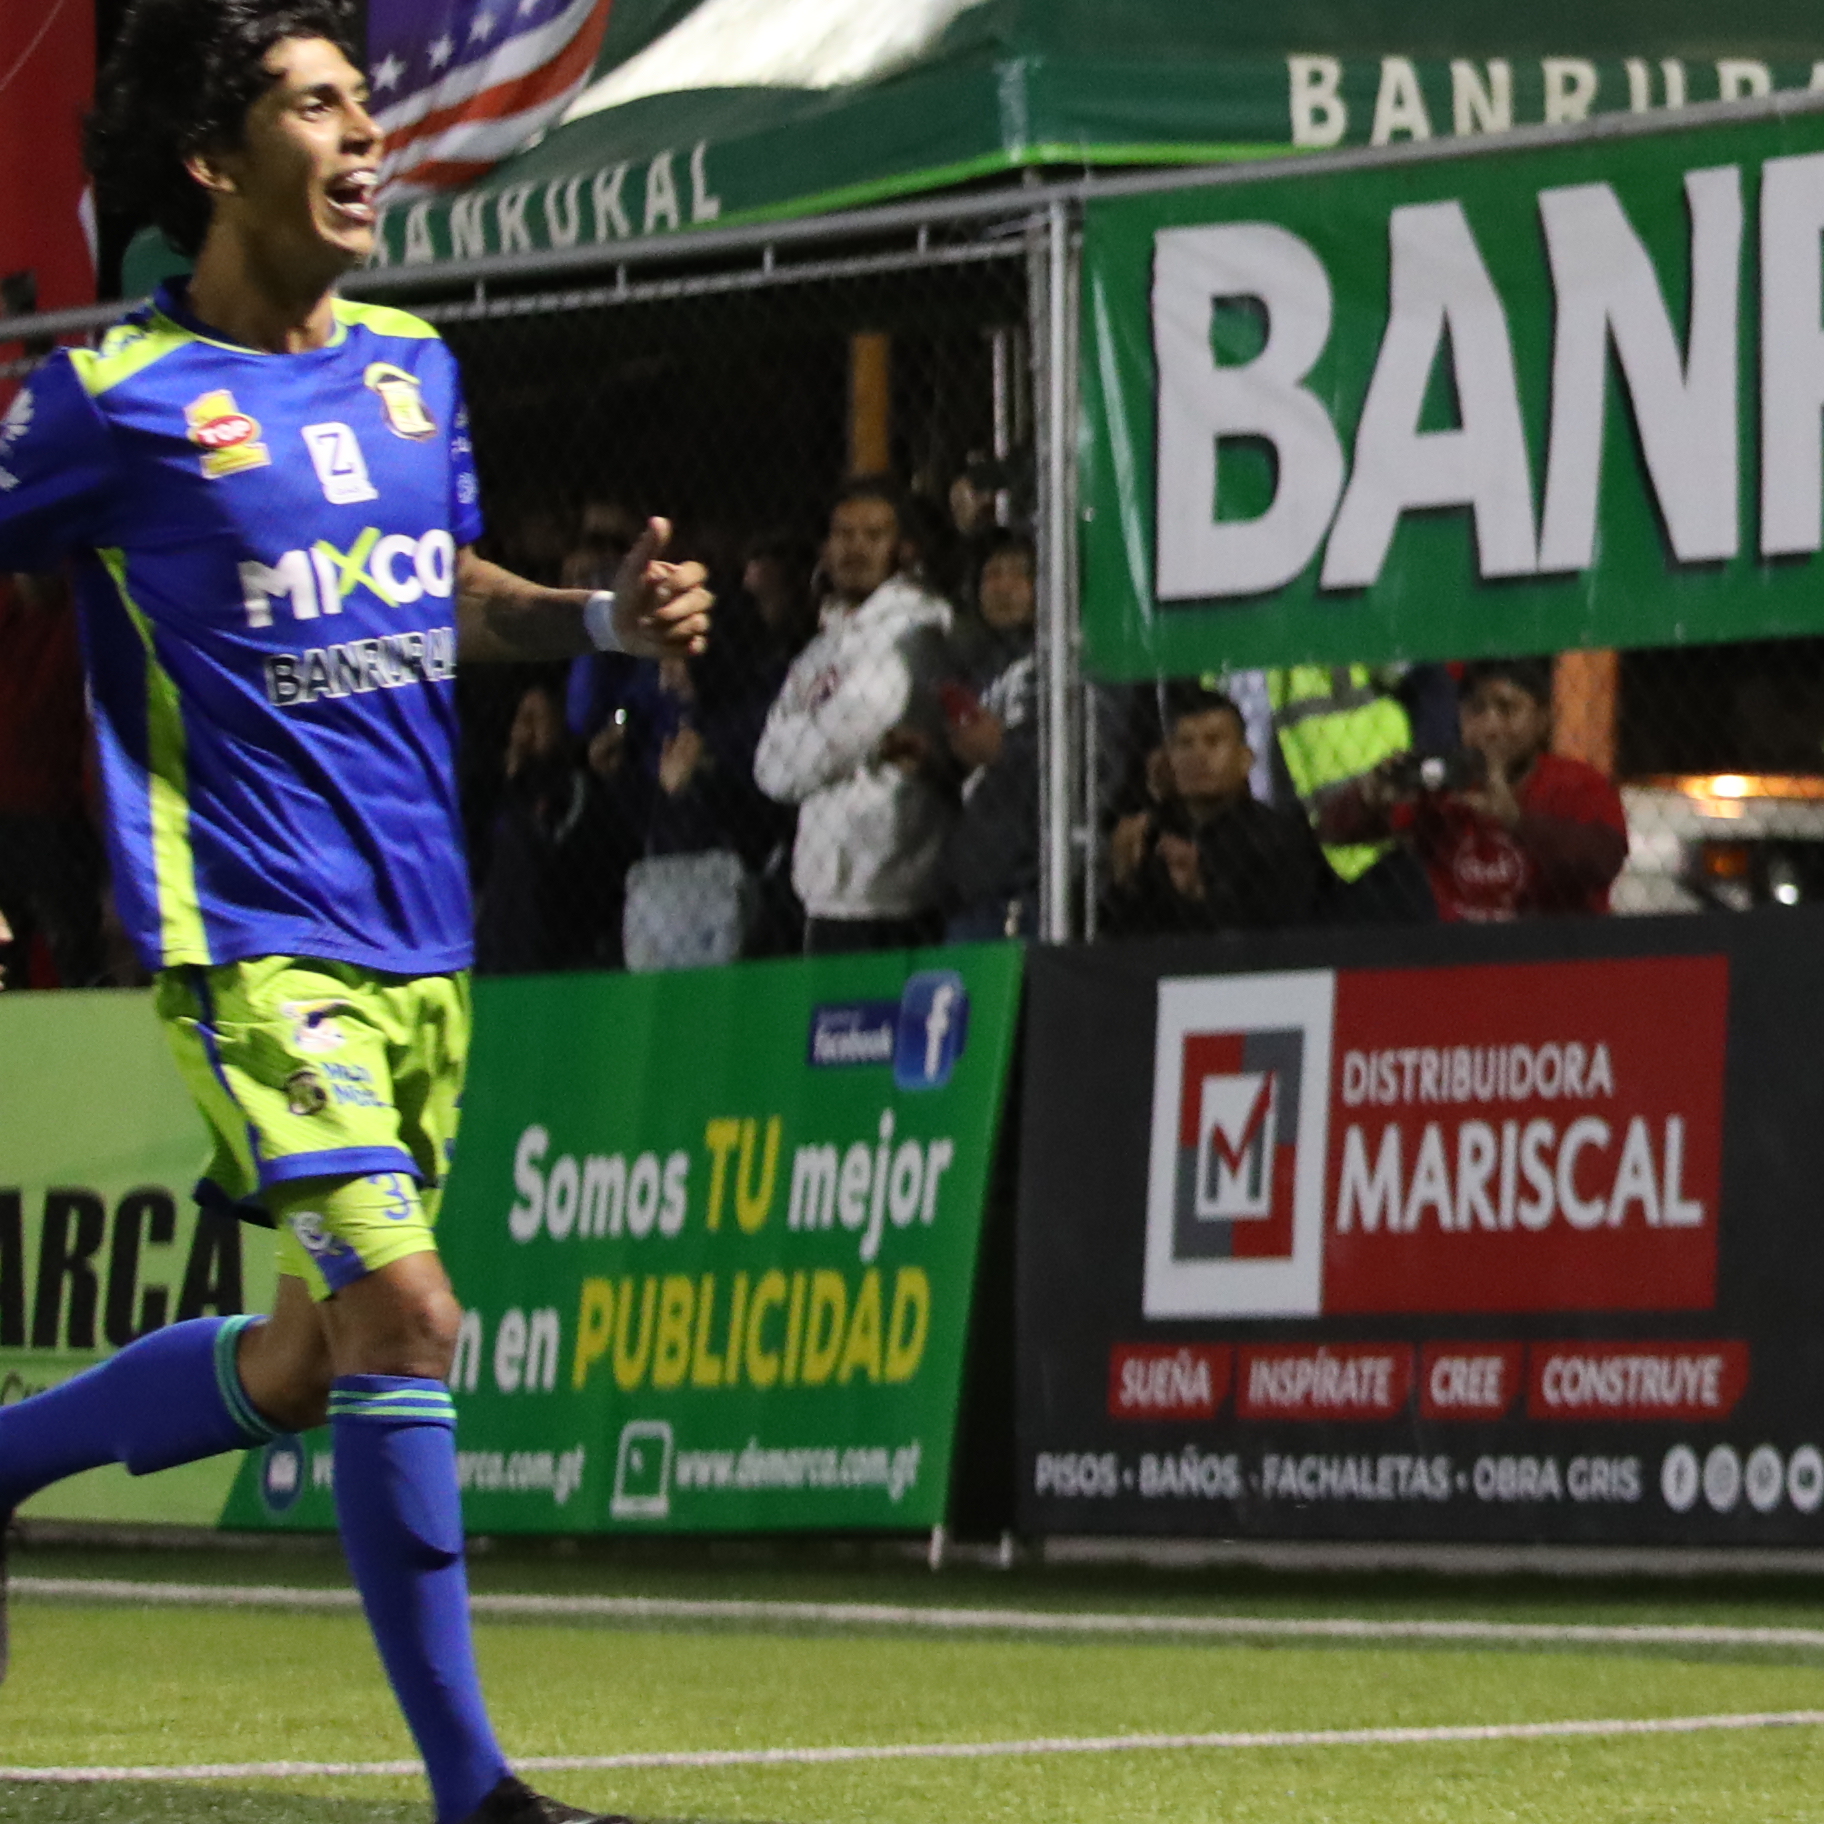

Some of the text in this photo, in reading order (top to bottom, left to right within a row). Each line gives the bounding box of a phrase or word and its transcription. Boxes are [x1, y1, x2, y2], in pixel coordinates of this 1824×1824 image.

[315, 431, 354, 475] Z
[237, 526, 456, 629] MIXCO
[1341, 1040, 1615, 1107] DISTRIBUIDORA
[508, 1107, 955, 1263] Somos TU mejor
[1334, 1113, 1706, 1234] MARISCAL
[496, 1306, 560, 1393] en
[570, 1267, 932, 1393] PUBLICIDAD
[1118, 1345, 1723, 1408] SUEÑA INSPÍRATE CREE CONSTRUYE
[1035, 1442, 1643, 1503] PISOS BAÑOS FACHALETAS OBRA GRIS
